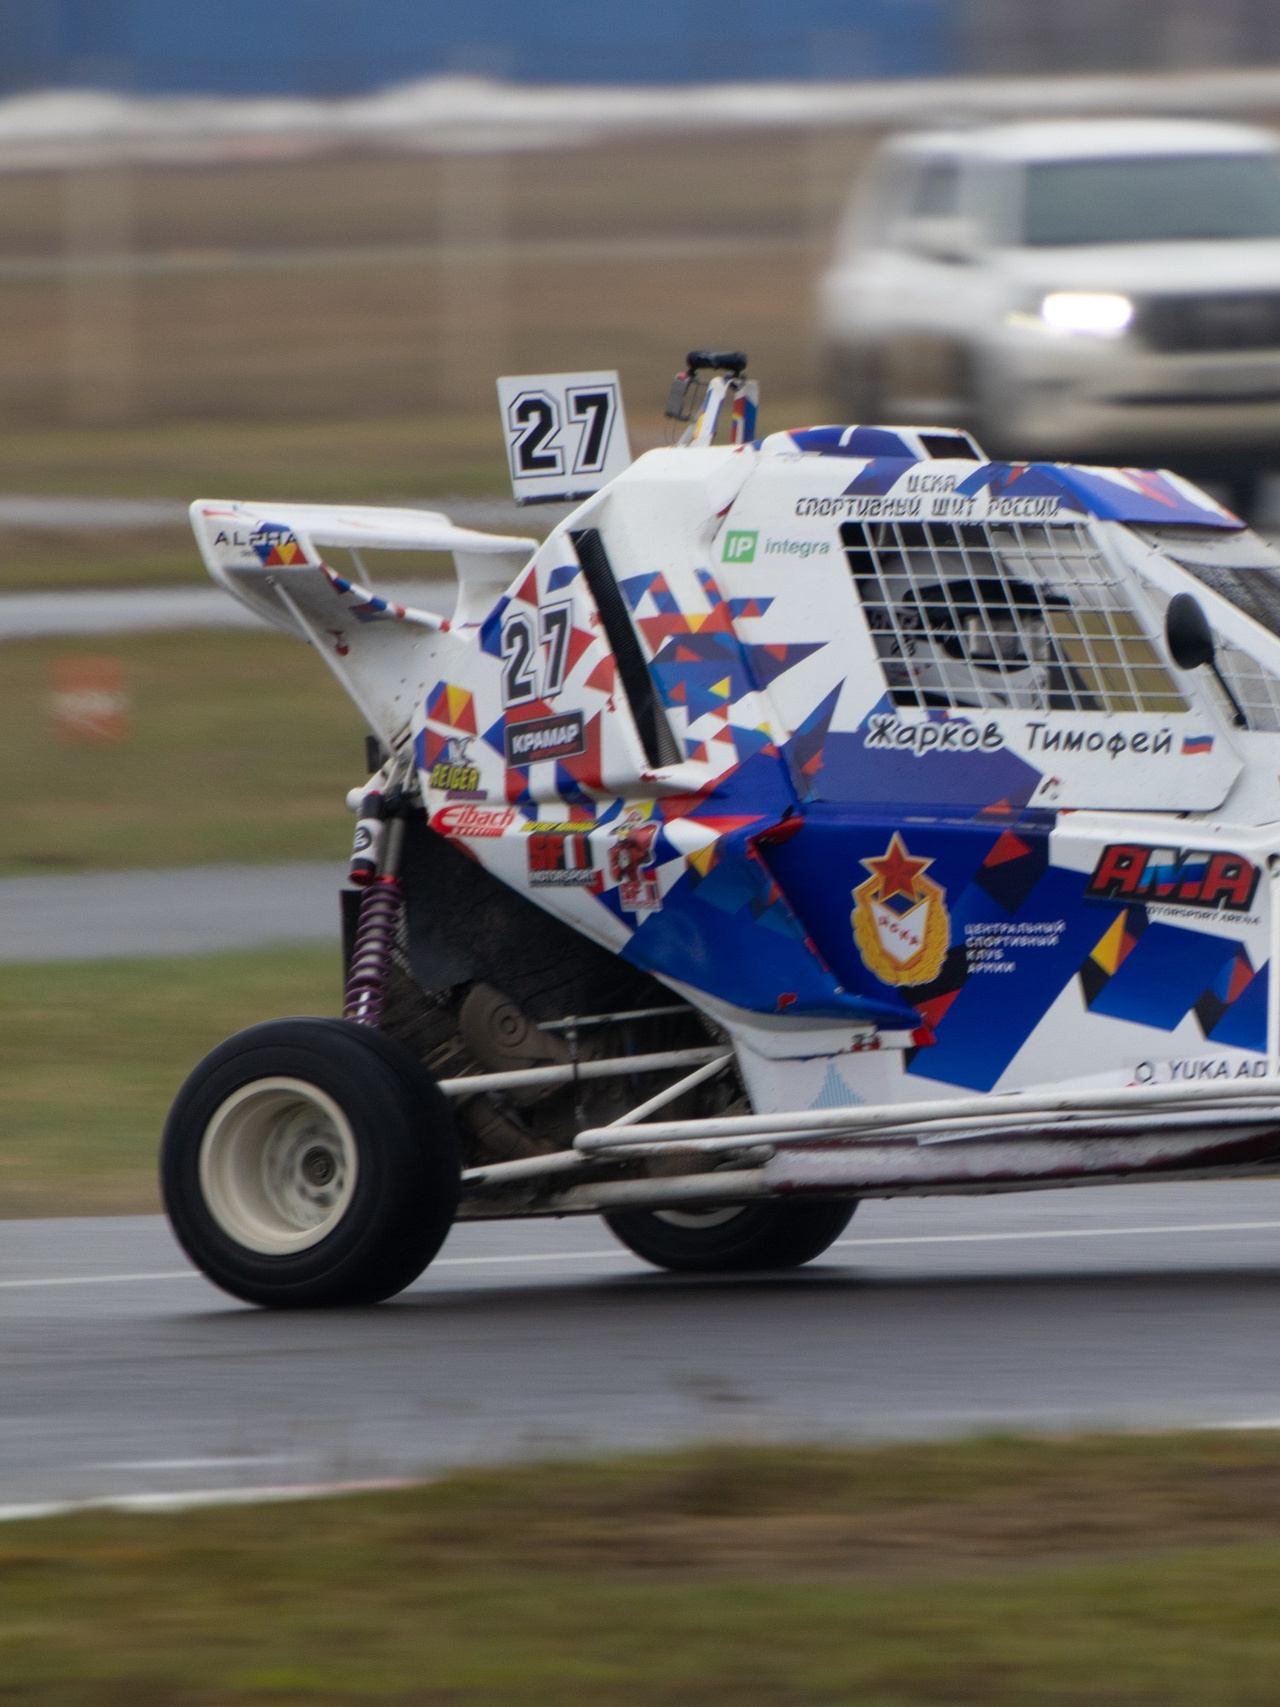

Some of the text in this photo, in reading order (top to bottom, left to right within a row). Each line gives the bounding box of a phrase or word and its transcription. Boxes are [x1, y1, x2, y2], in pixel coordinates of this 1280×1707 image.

[507, 383, 618, 480] 27
[906, 474, 956, 493] ЦСКА
[795, 494, 922, 518] СПОРТИВНЫЙ
[985, 495, 1062, 518] РОССИИ
[213, 530, 298, 547] ALPHA
[726, 534, 830, 560] IP integra
[501, 598, 575, 711] 27
[511, 722, 580, 755] КРАМАР
[866, 713, 1173, 760] Жарков Тимофей
[429, 763, 481, 791] REIGER
[428, 804, 517, 832] Eibach
[1087, 844, 1260, 908] AMA
[1146, 904, 1218, 921] OTORSPORT
[964, 919, 1067, 935] ЦЕНТРАЛЬНЫЙ
[964, 933, 1060, 948] СПОРТИВНЫЙ
[965, 948, 1005, 961] КЛУБ
[966, 961, 1017, 974] АРМИИ
[1168, 1059, 1229, 1080] YUKA
